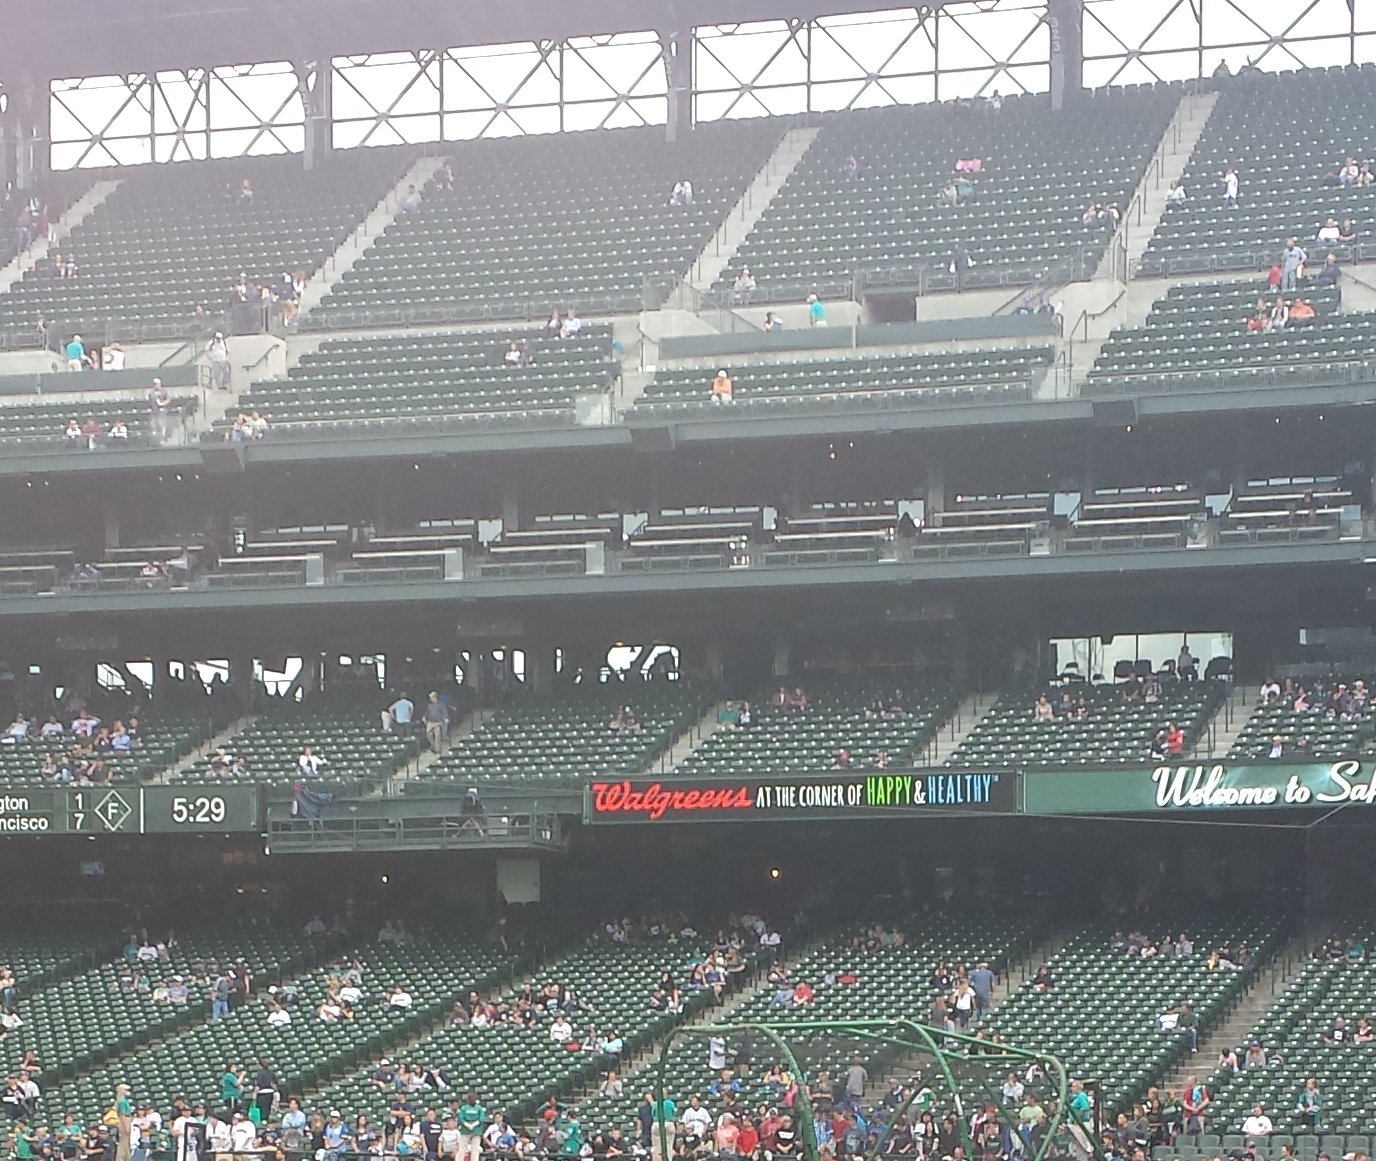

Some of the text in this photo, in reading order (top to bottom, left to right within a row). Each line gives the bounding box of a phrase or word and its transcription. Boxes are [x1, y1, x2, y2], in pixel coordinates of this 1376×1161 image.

[591, 774, 992, 820] Walgreens AT THE CORNER OF HAPPY & HEALTHY
[1151, 765, 1277, 807] Welcome
[1284, 775, 1312, 804] to
[74, 794, 83, 810] 1
[107, 802, 119, 820] F
[172, 797, 226, 823] 5:29
[74, 813, 85, 831] 7
